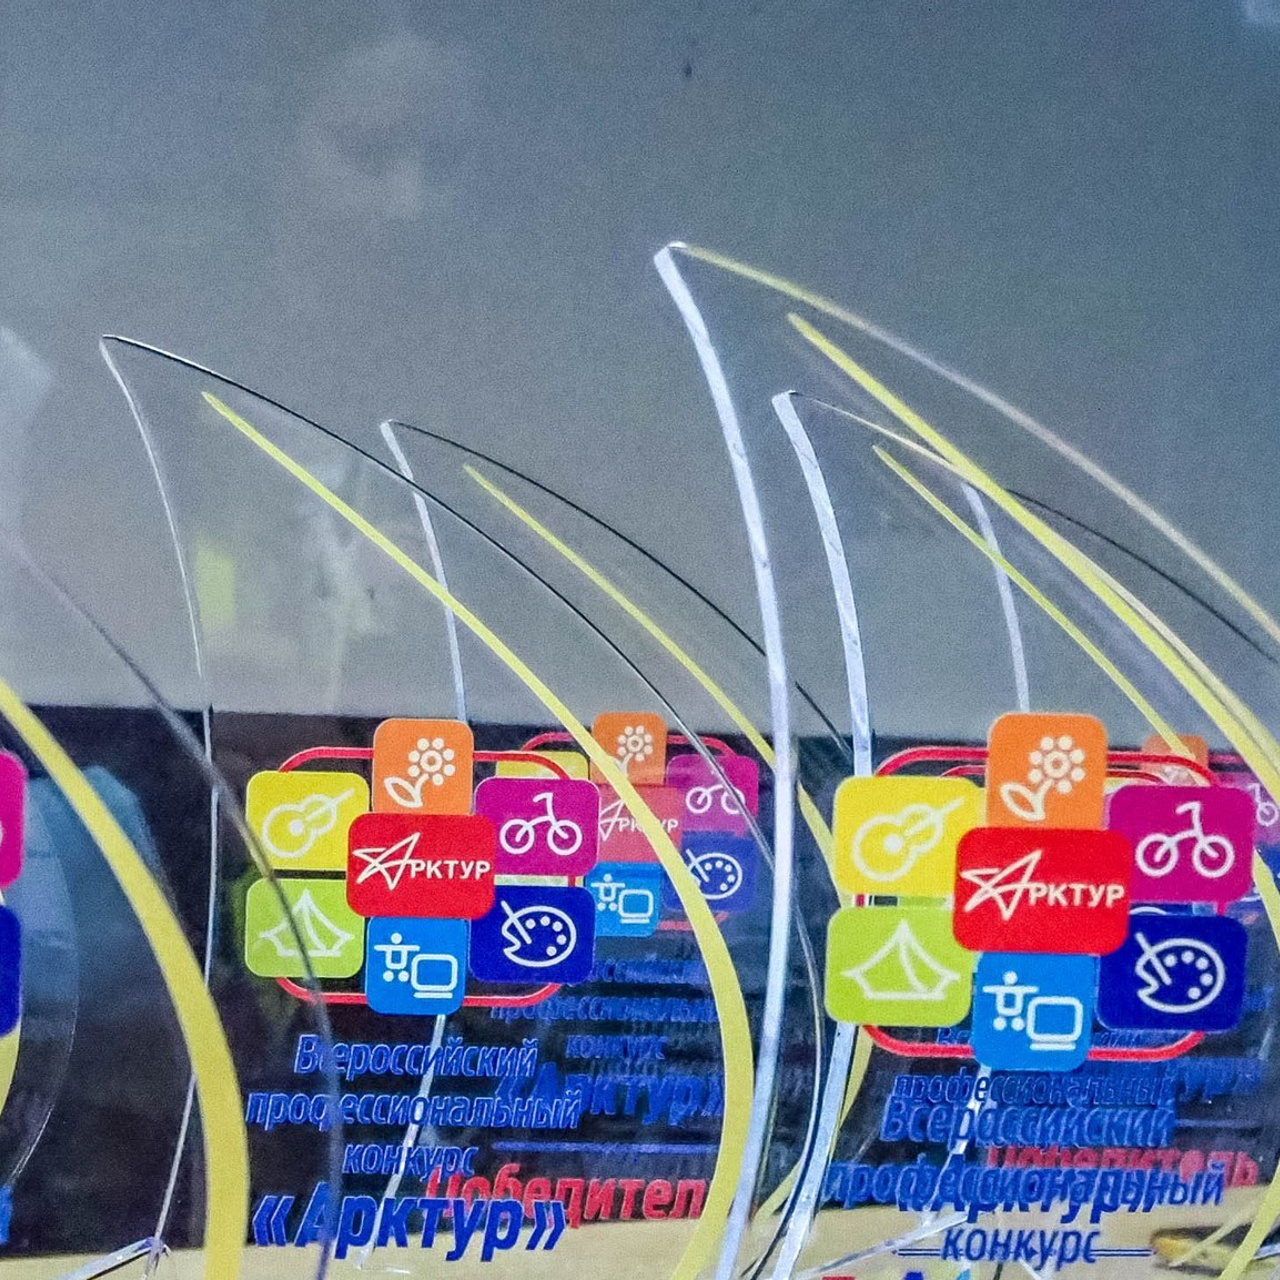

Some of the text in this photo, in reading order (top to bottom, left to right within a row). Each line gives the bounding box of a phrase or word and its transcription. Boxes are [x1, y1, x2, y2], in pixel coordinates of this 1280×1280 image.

[353, 832, 491, 890] АРКТУР
[961, 849, 1125, 921] АРКТУР
[294, 1033, 539, 1080] Вероссийский
[341, 1143, 480, 1183] конкурс
[940, 1227, 1102, 1272] конкурс
